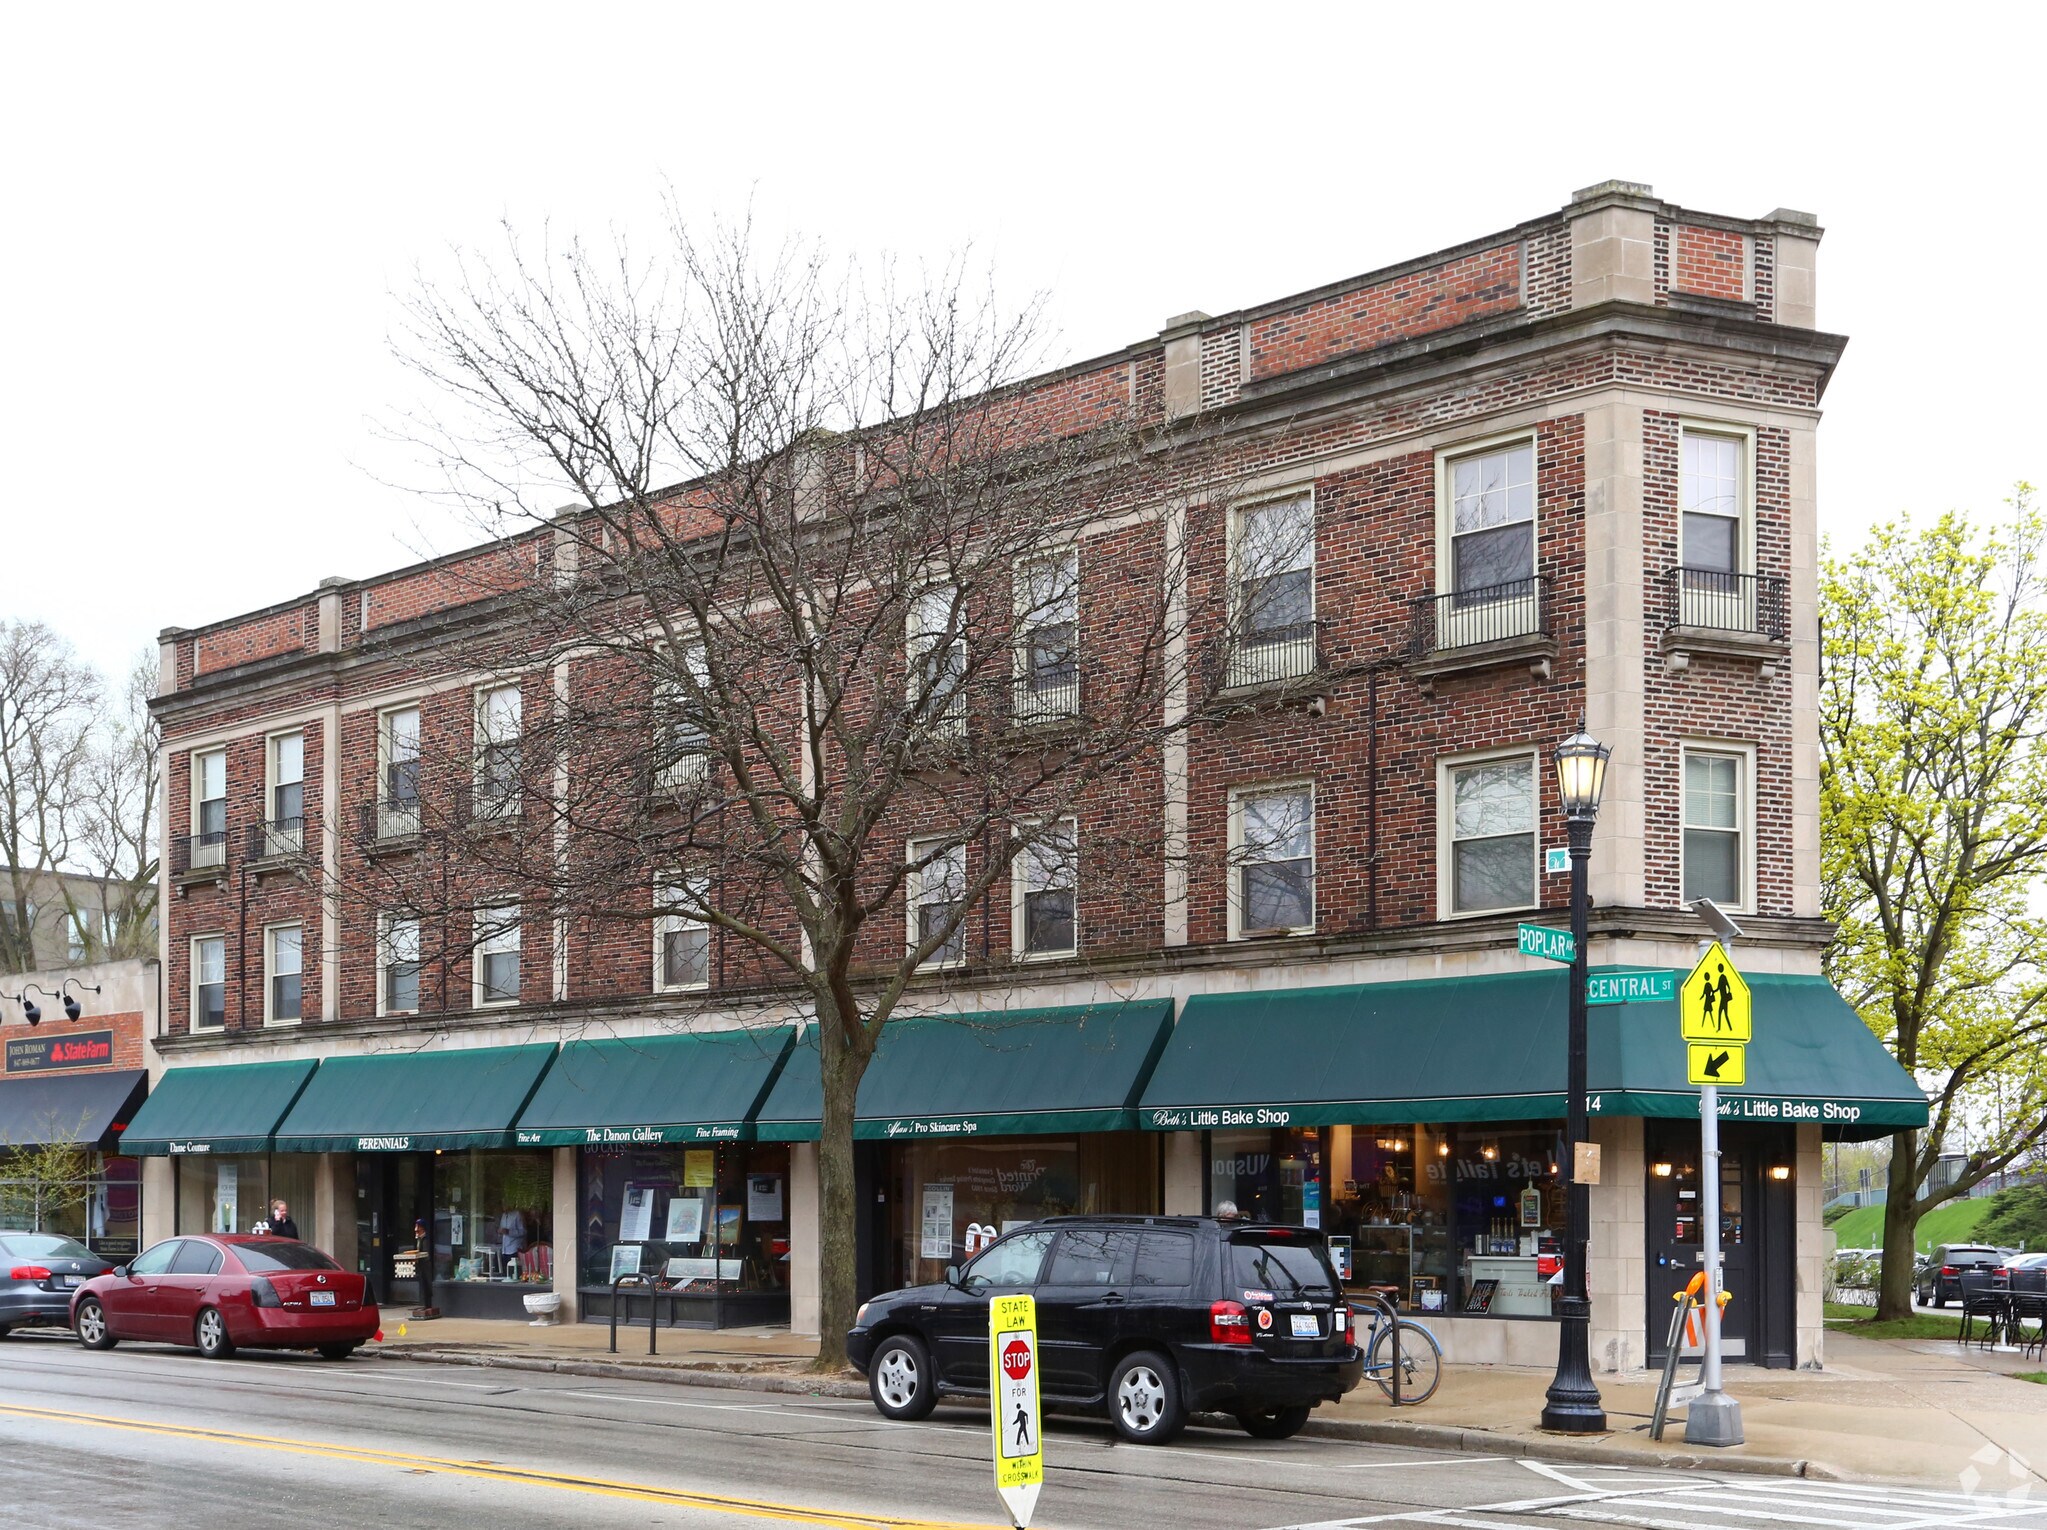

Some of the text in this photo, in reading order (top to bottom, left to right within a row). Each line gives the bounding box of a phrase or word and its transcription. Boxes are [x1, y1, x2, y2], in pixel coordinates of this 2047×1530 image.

[1520, 928, 1566, 957] POPLAR
[1589, 977, 1672, 998] CENTRAL ST
[9, 1043, 46, 1057] JOHN ROMAN
[1152, 1109, 1290, 1126] Beth's Little Bake Shop
[1744, 1100, 1778, 1117] Little
[1782, 1101, 1819, 1118] Bake
[1823, 1102, 1861, 1122] Shop
[696, 1126, 739, 1138] Fine Framing
[914, 1122, 928, 1133] Pro
[929, 1121, 961, 1133] Skincare
[962, 1120, 977, 1134] Spa
[517, 1132, 542, 1143] Fine Art
[585, 1127, 664, 1143] The Danon Gallery
[357, 1136, 409, 1150] PERENNIALS
[584, 1142, 600, 1154] GO
[1001, 1300, 1029, 1314] STATE
[1006, 1316, 1026, 1328] LAW
[1004, 1351, 1031, 1369] STOP
[1011, 1387, 1027, 1398] FOR
[1011, 1459, 1032, 1470] WITHIN
[1002, 1470, 1039, 1484] CROSSWALK
